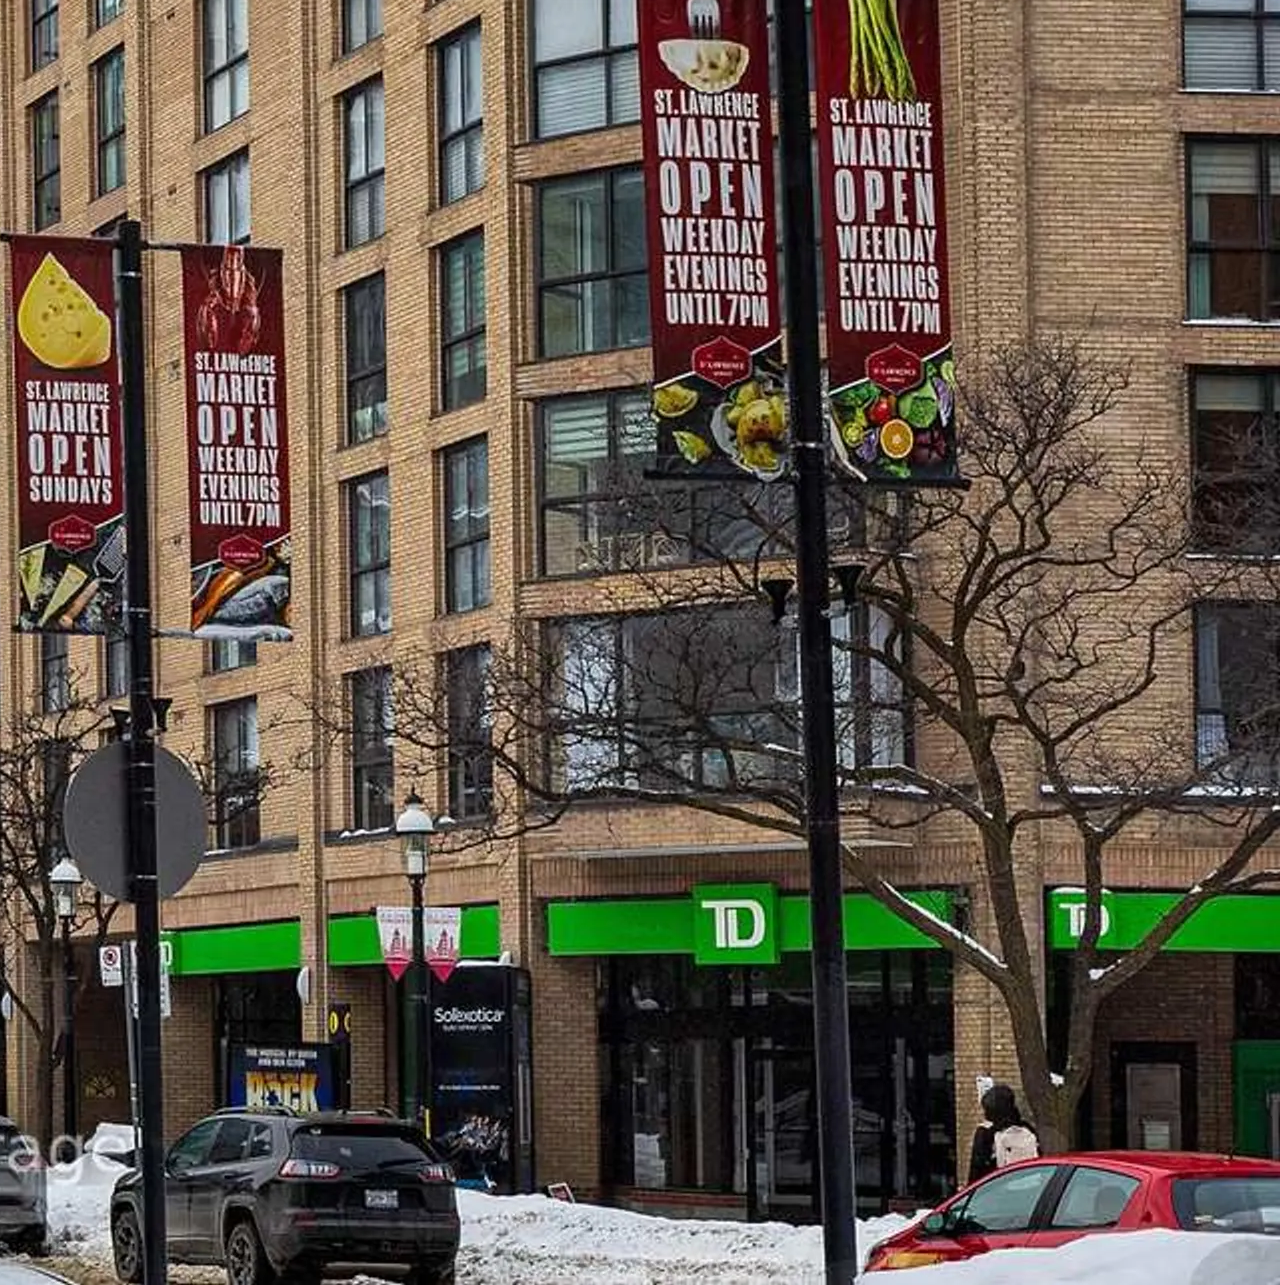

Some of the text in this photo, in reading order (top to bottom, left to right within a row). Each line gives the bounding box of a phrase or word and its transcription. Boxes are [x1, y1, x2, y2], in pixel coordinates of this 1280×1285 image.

[654, 89, 759, 118] ST. LAWRENCE
[830, 98, 932, 127] ST. LAWRENCE
[656, 117, 760, 161] MARKET
[832, 125, 933, 169] MARKET
[660, 161, 763, 218] OPEN
[834, 169, 936, 226] OPEN
[660, 217, 765, 255] WEEKDAY
[836, 225, 937, 262] WEEKDAY
[663, 255, 767, 293] EVENINGS
[840, 262, 939, 300] EVENINGS
[665, 292, 769, 328] UNTIL 7PM
[840, 299, 941, 334] UNTIL 7PM
[195, 351, 276, 374] ST. LAWRENCE
[26, 380, 109, 402] ST. LAWRENCE
[196, 373, 277, 405] MARKET
[27, 401, 110, 434] MARKET
[198, 405, 278, 446] OPEN
[28, 433, 112, 476] OPEN
[197, 446, 279, 475] WEEKDAY
[29, 475, 113, 504] SUNDAYS
[199, 474, 280, 502] EVENINGS
[200, 501, 281, 527] UNTIL 7PM
[702, 900, 766, 948] TD
[246, 1071, 318, 1112] ROCK
